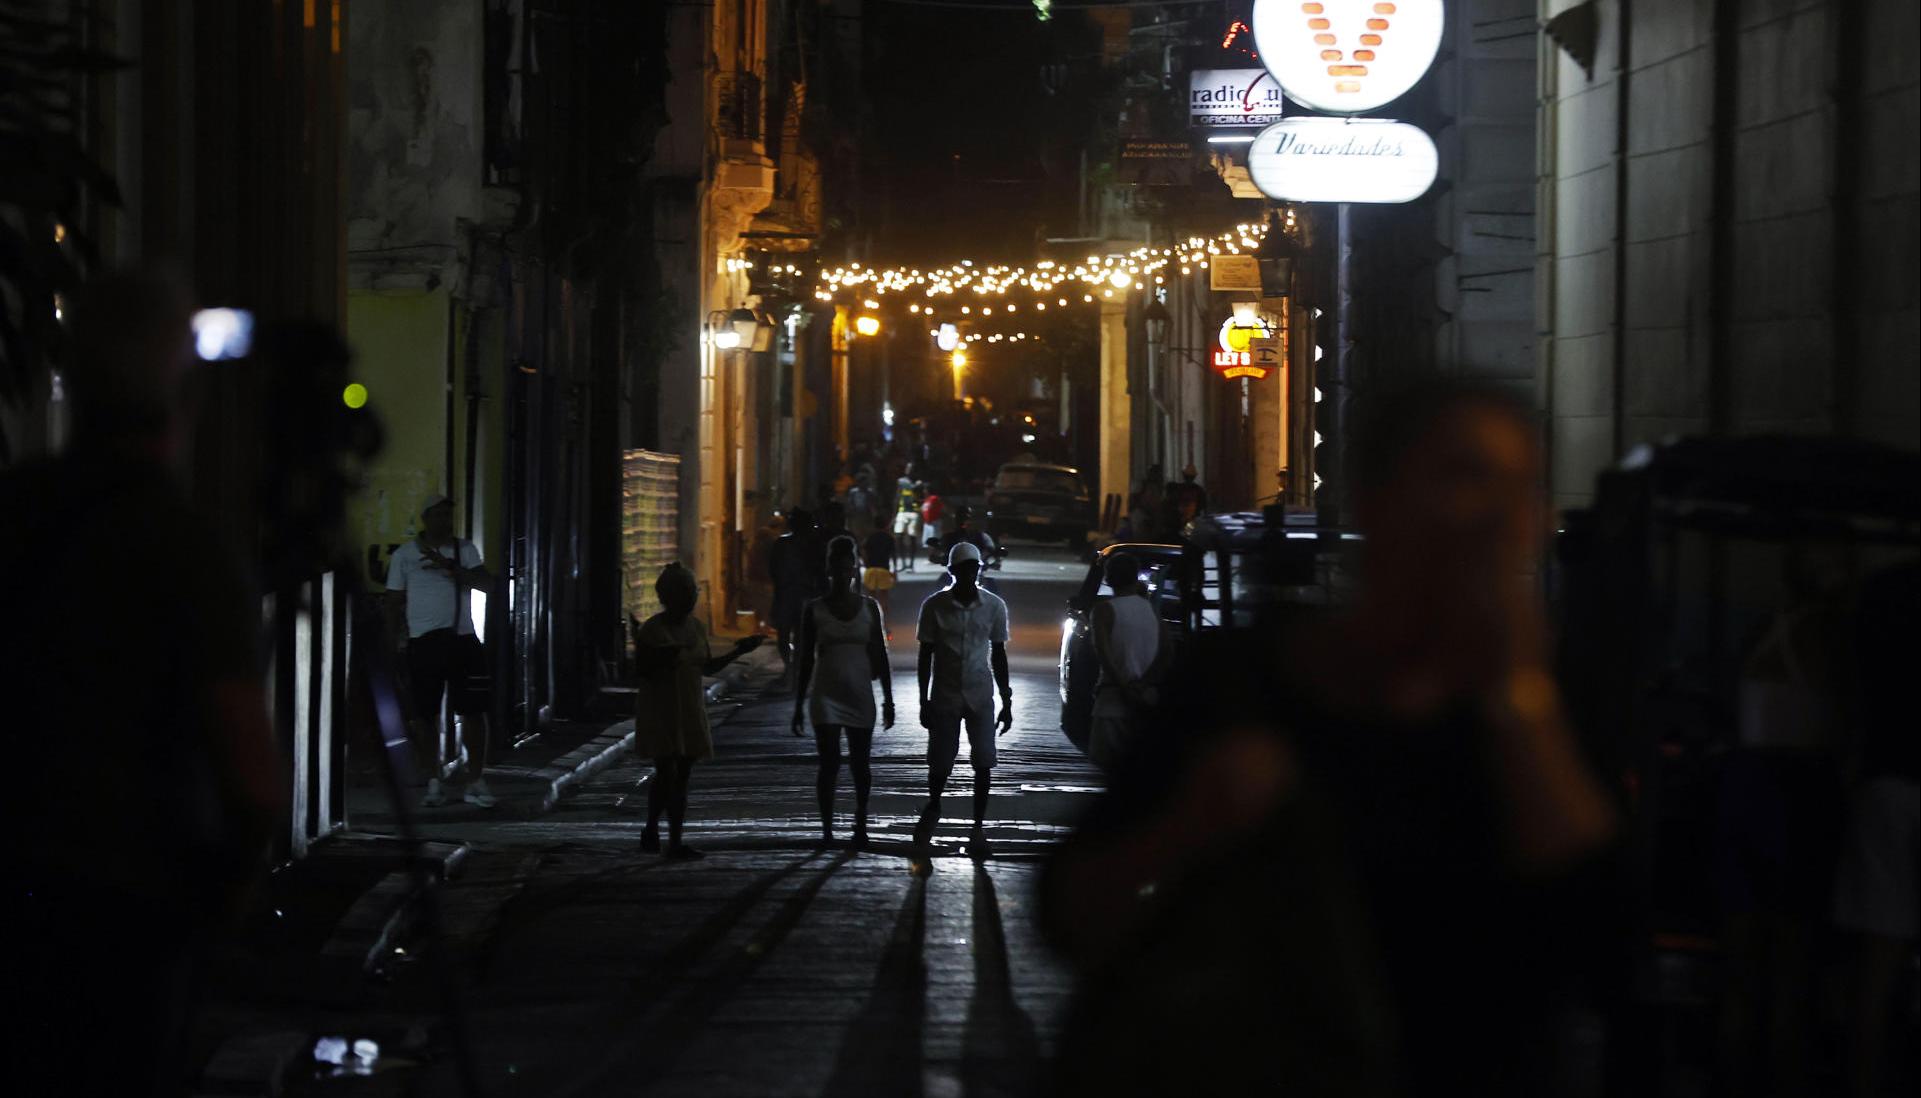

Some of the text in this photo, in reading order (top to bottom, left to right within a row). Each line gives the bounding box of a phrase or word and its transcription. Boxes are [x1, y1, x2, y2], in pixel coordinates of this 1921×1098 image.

[1299, 0, 1398, 94] V
[1200, 115, 1247, 124] OFICINA
[1273, 131, 1406, 158] Variedades
